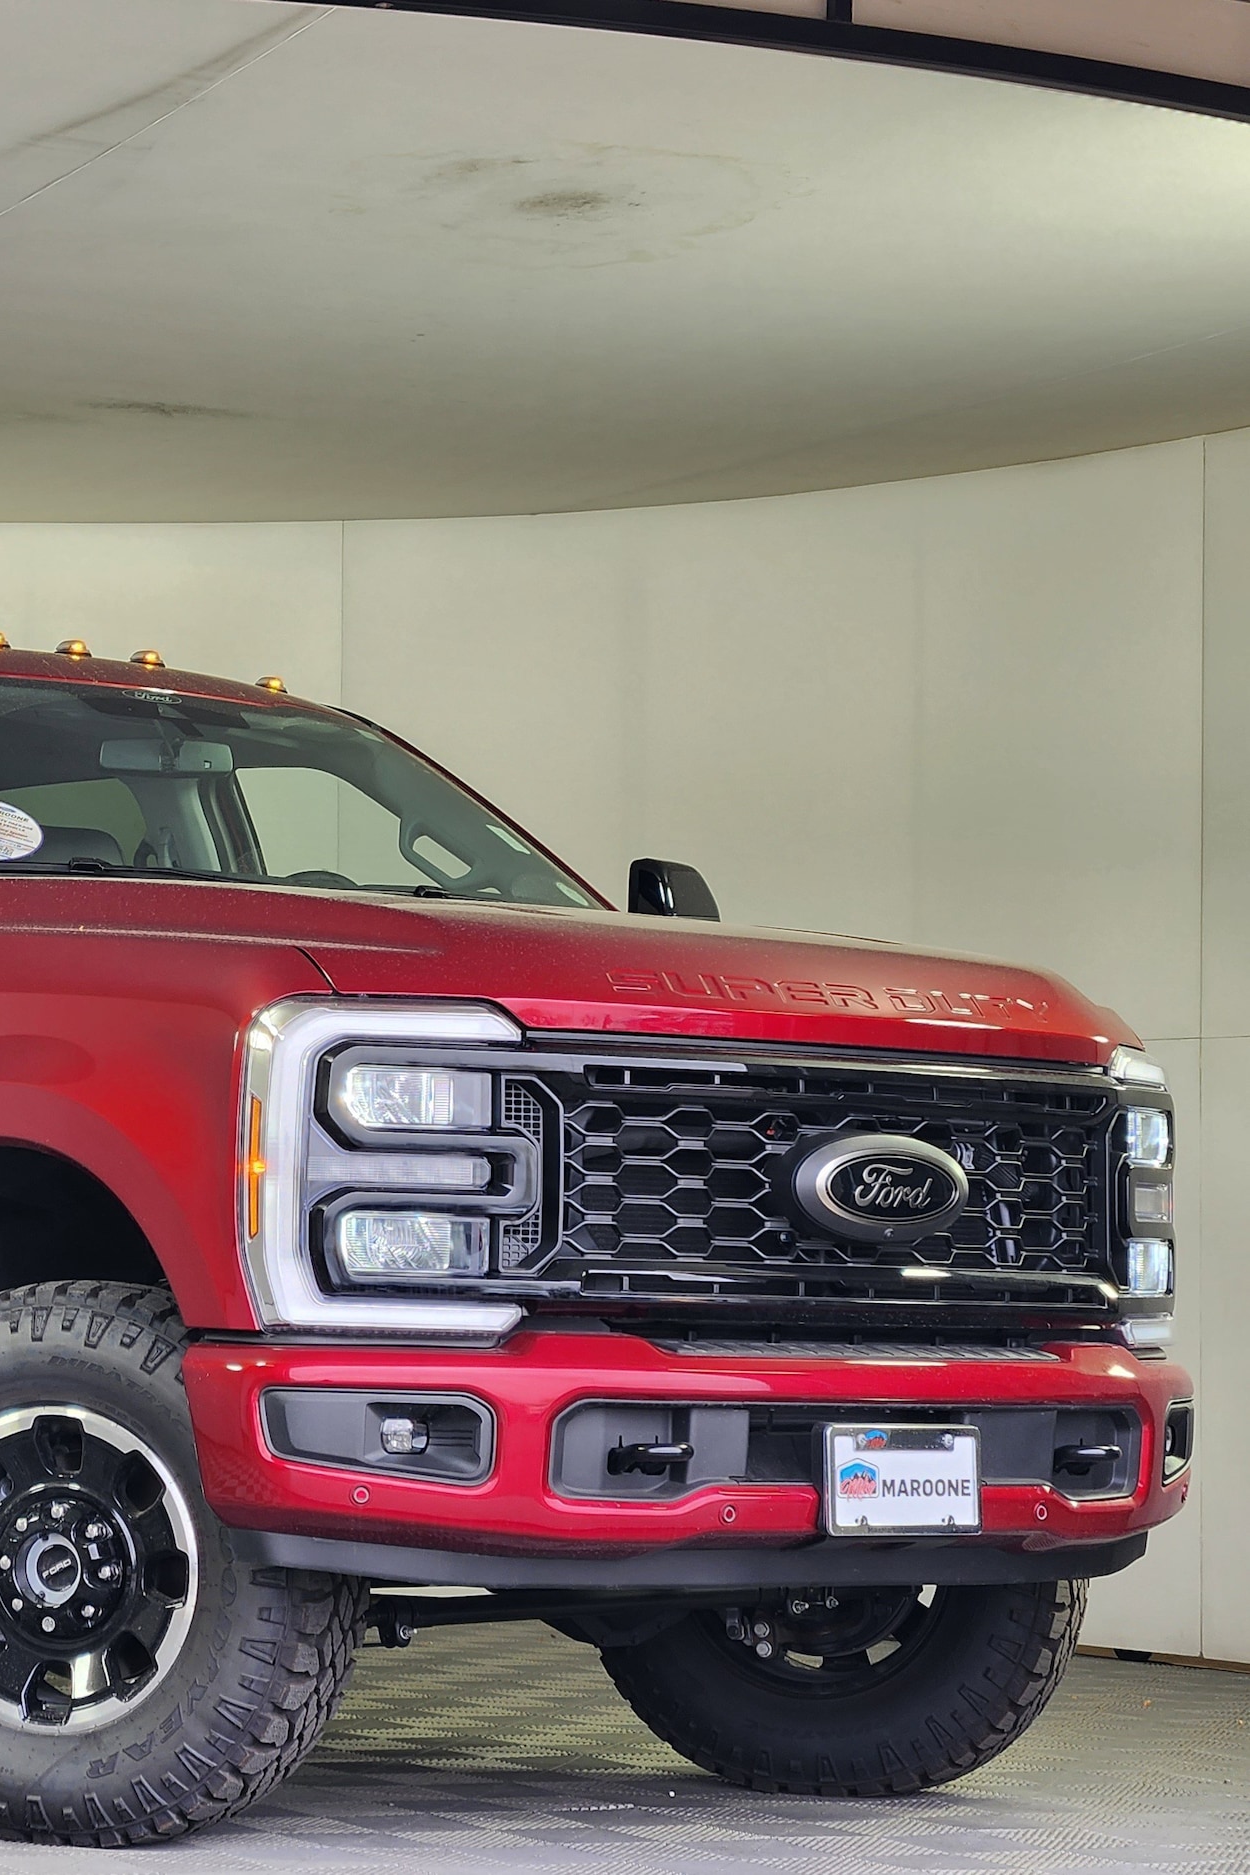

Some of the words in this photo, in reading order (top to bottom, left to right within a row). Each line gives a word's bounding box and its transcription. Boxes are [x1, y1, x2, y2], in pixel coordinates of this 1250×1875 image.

[134, 691, 172, 703] Ford
[606, 967, 879, 1010] SUPER
[883, 986, 1049, 1024] DUTY
[854, 1163, 933, 1209] Ford
[881, 1479, 971, 1497] MAROONE
[41, 1558, 72, 1580] FORD
[86, 1526, 238, 1779] OODYEAR
